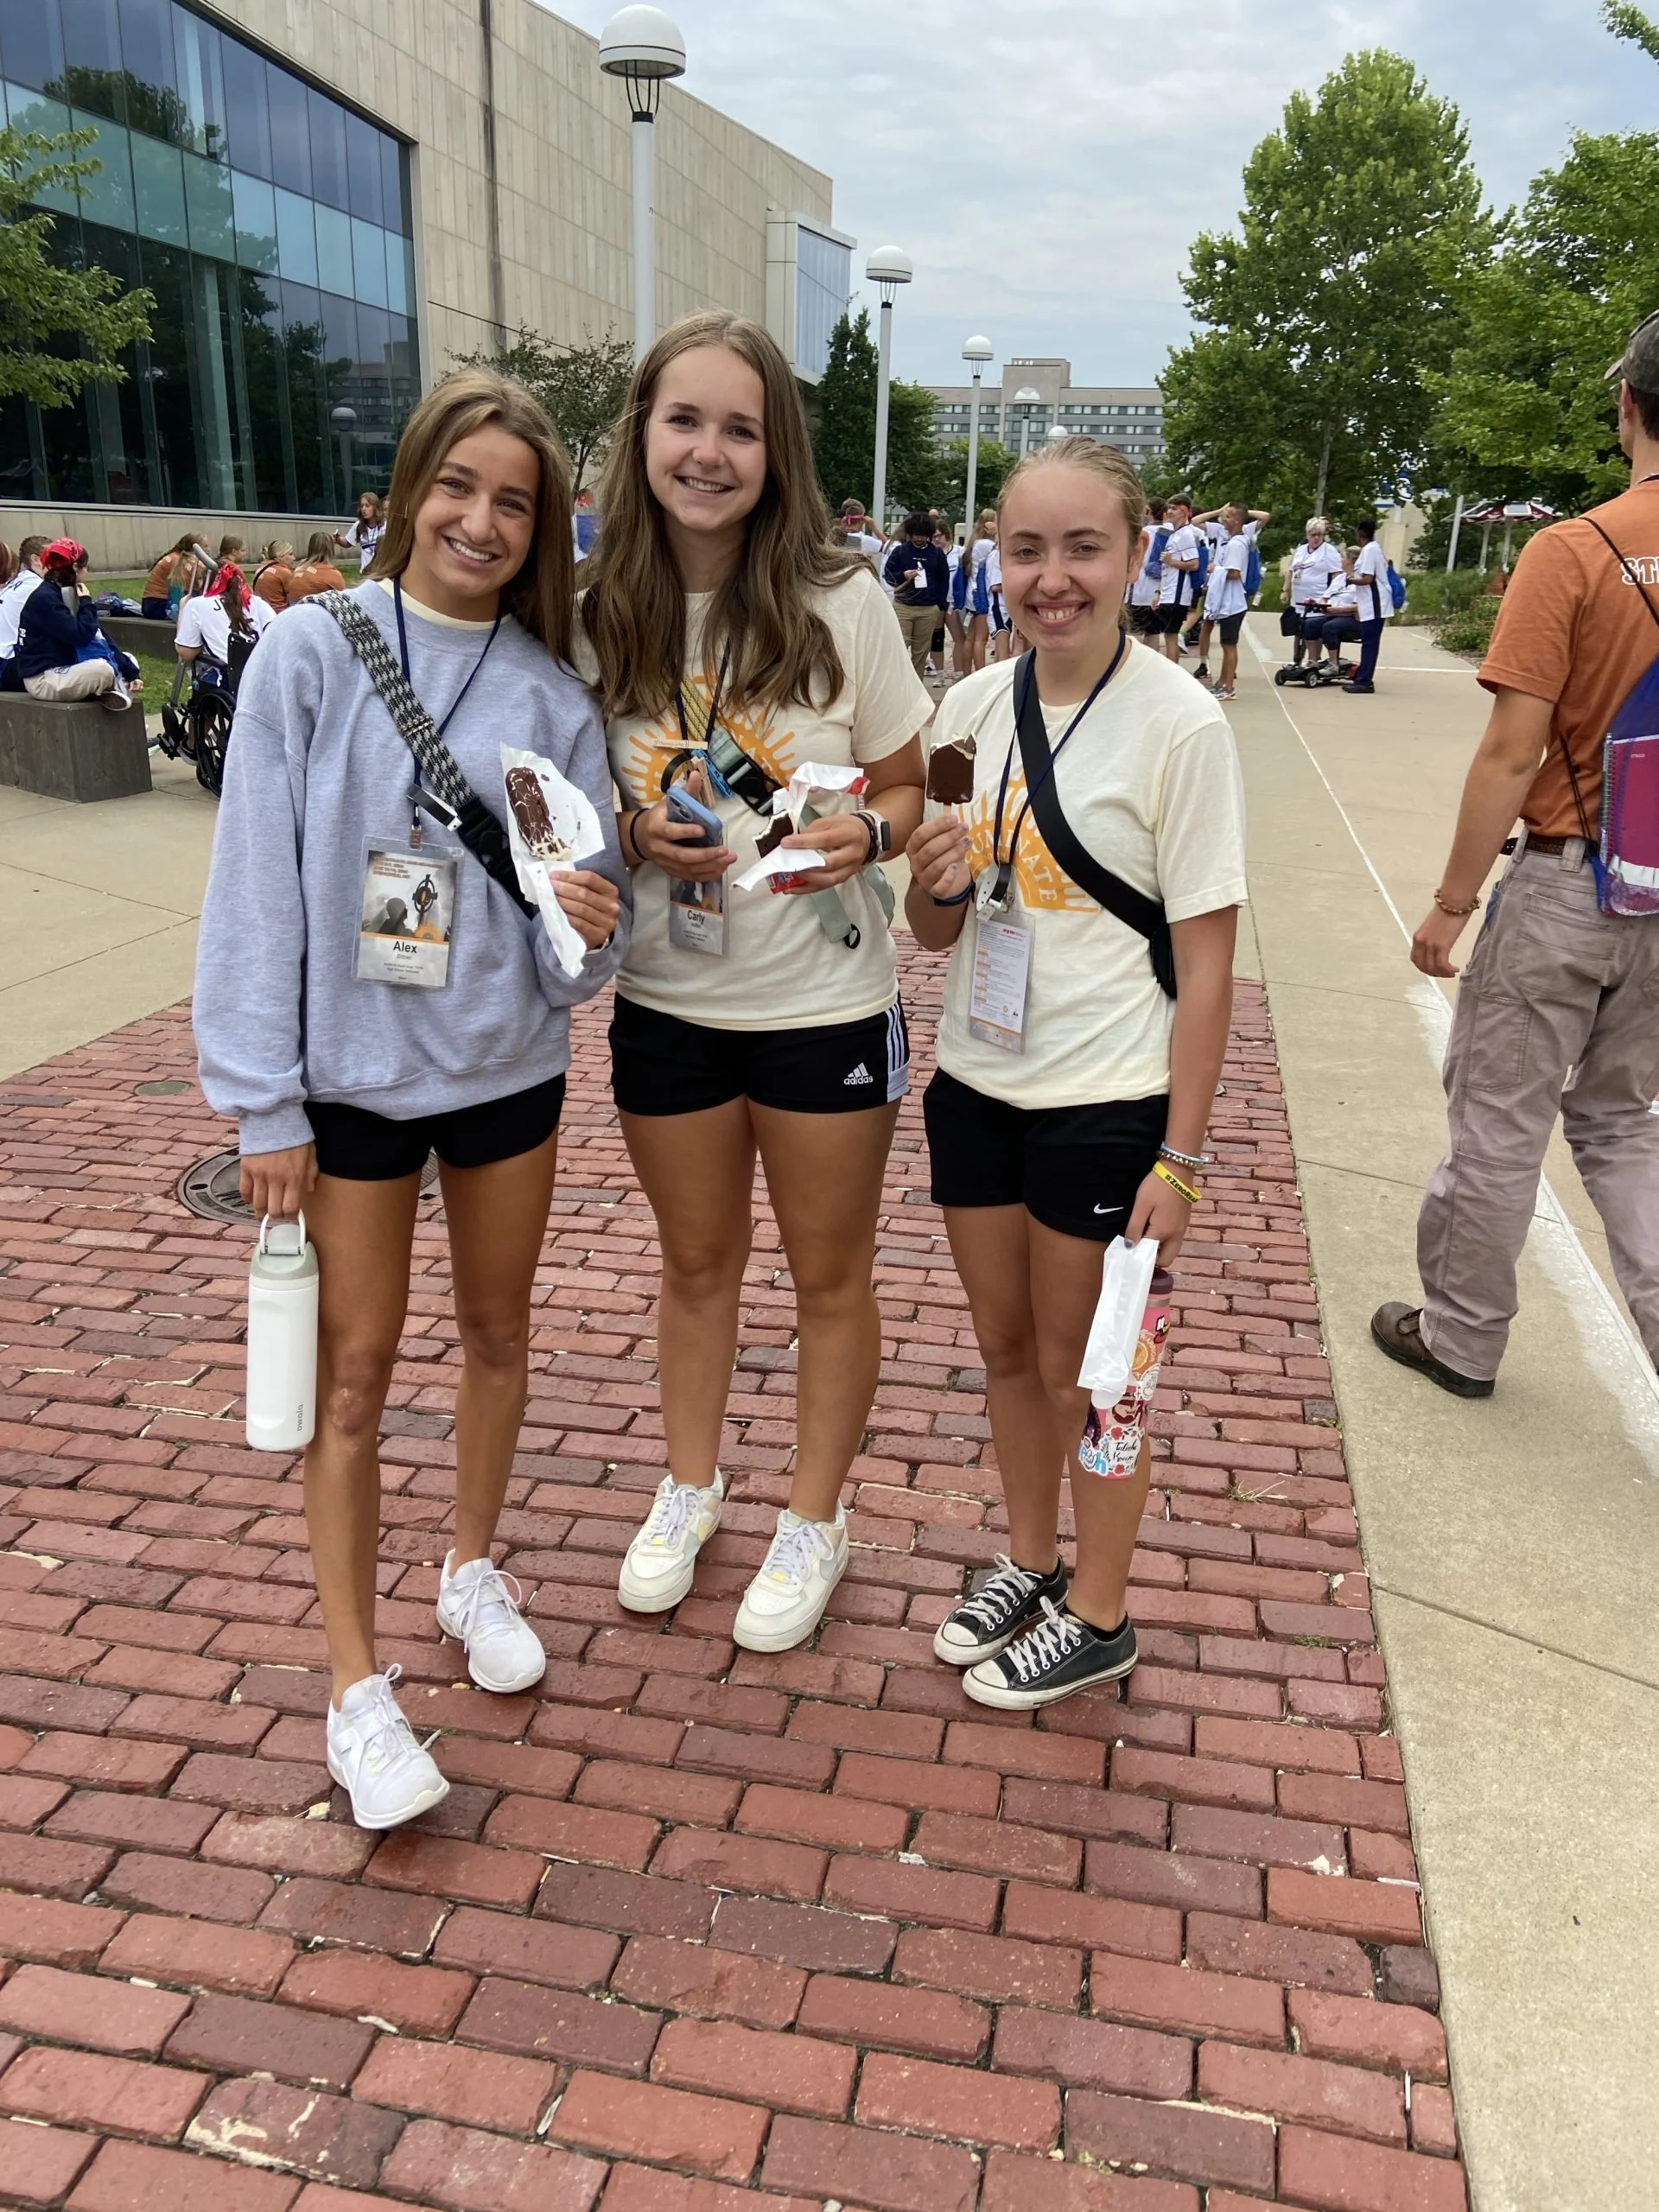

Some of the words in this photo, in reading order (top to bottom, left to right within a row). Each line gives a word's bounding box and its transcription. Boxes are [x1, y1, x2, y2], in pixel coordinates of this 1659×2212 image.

[687, 909, 706, 925] Carly
[392, 940, 418, 954] Alex
[843, 1075, 874, 1085] adidas
